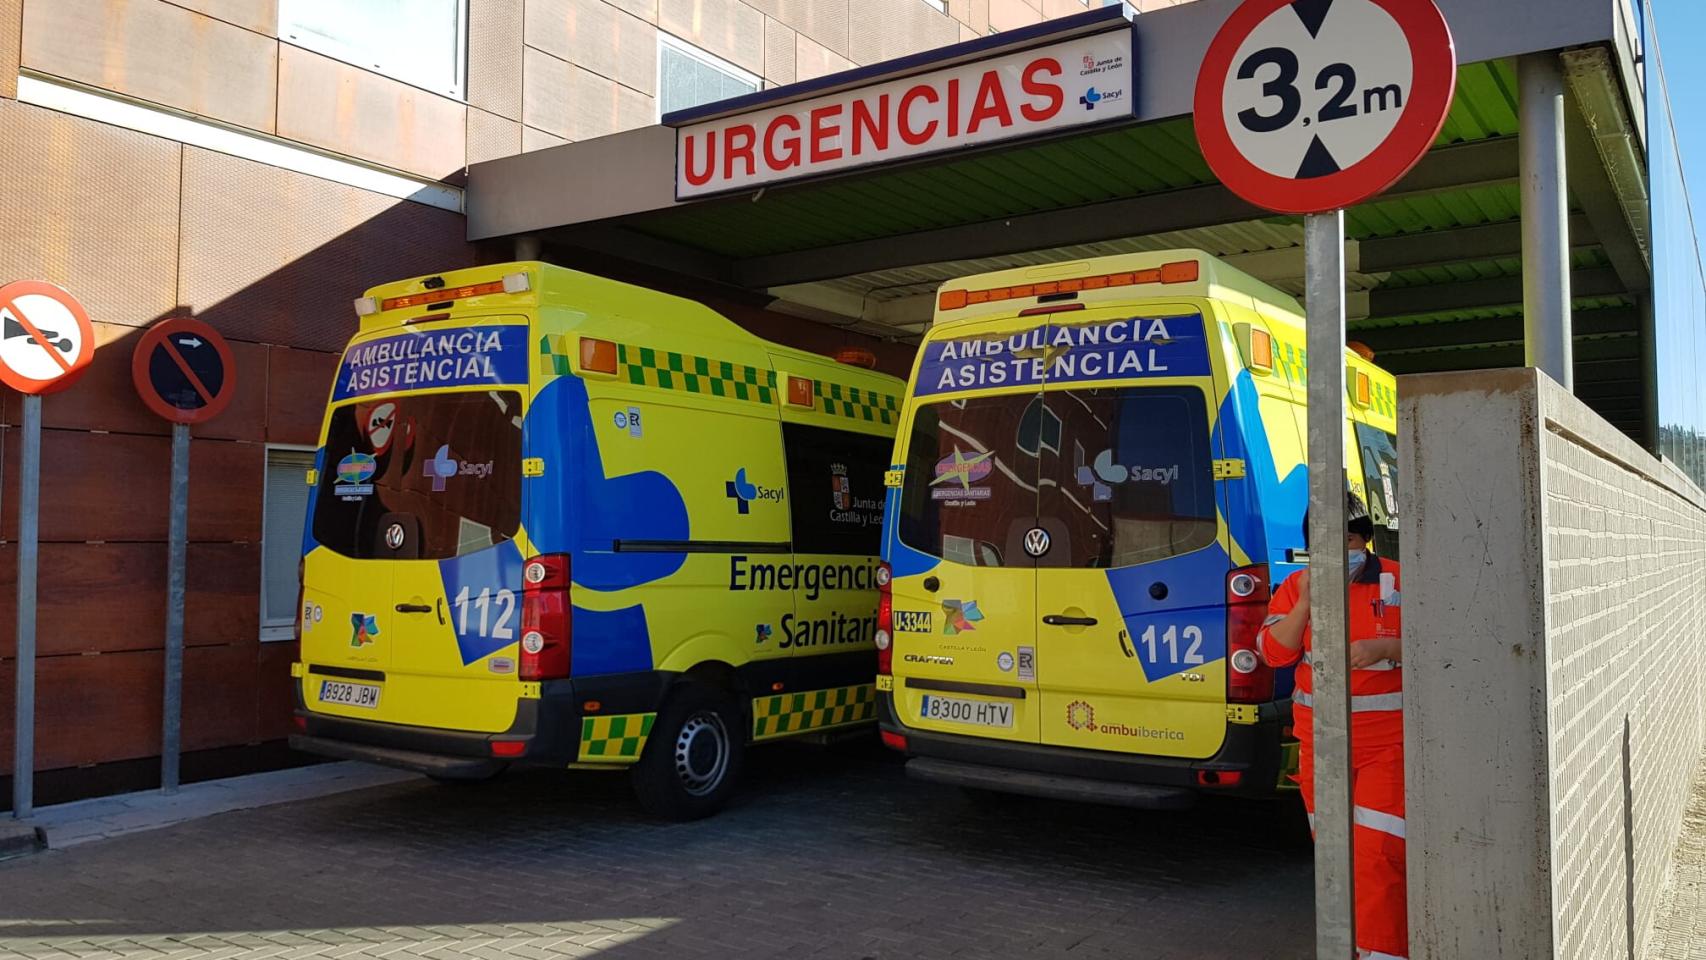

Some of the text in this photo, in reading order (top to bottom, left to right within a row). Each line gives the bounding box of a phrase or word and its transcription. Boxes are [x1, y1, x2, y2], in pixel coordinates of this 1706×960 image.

[1102, 89, 1122, 100] Sacyl
[684, 57, 1064, 186] URGENCIAS
[350, 331, 502, 370] AMBULANCIA
[939, 318, 1170, 362] AMBULANCIA
[346, 356, 495, 393] ASISTENCIAL
[937, 349, 1168, 389] ASISTENCIAL
[458, 460, 493, 478] Sacyl
[1131, 464, 1179, 486] Sacyl
[757, 486, 784, 503] Sacyl
[853, 497, 877, 510] Junta
[830, 509, 861, 523] Castilla
[862, 514, 867, 527] y
[455, 585, 515, 640] 112
[894, 611, 931, 632] U-3344
[1142, 624, 1204, 664] 112
[904, 654, 954, 666] CRAFTER
[326, 683, 353, 702] 8928
[931, 699, 1009, 725] 8300 HTV
[1101, 724, 1184, 741] ambuiberica
